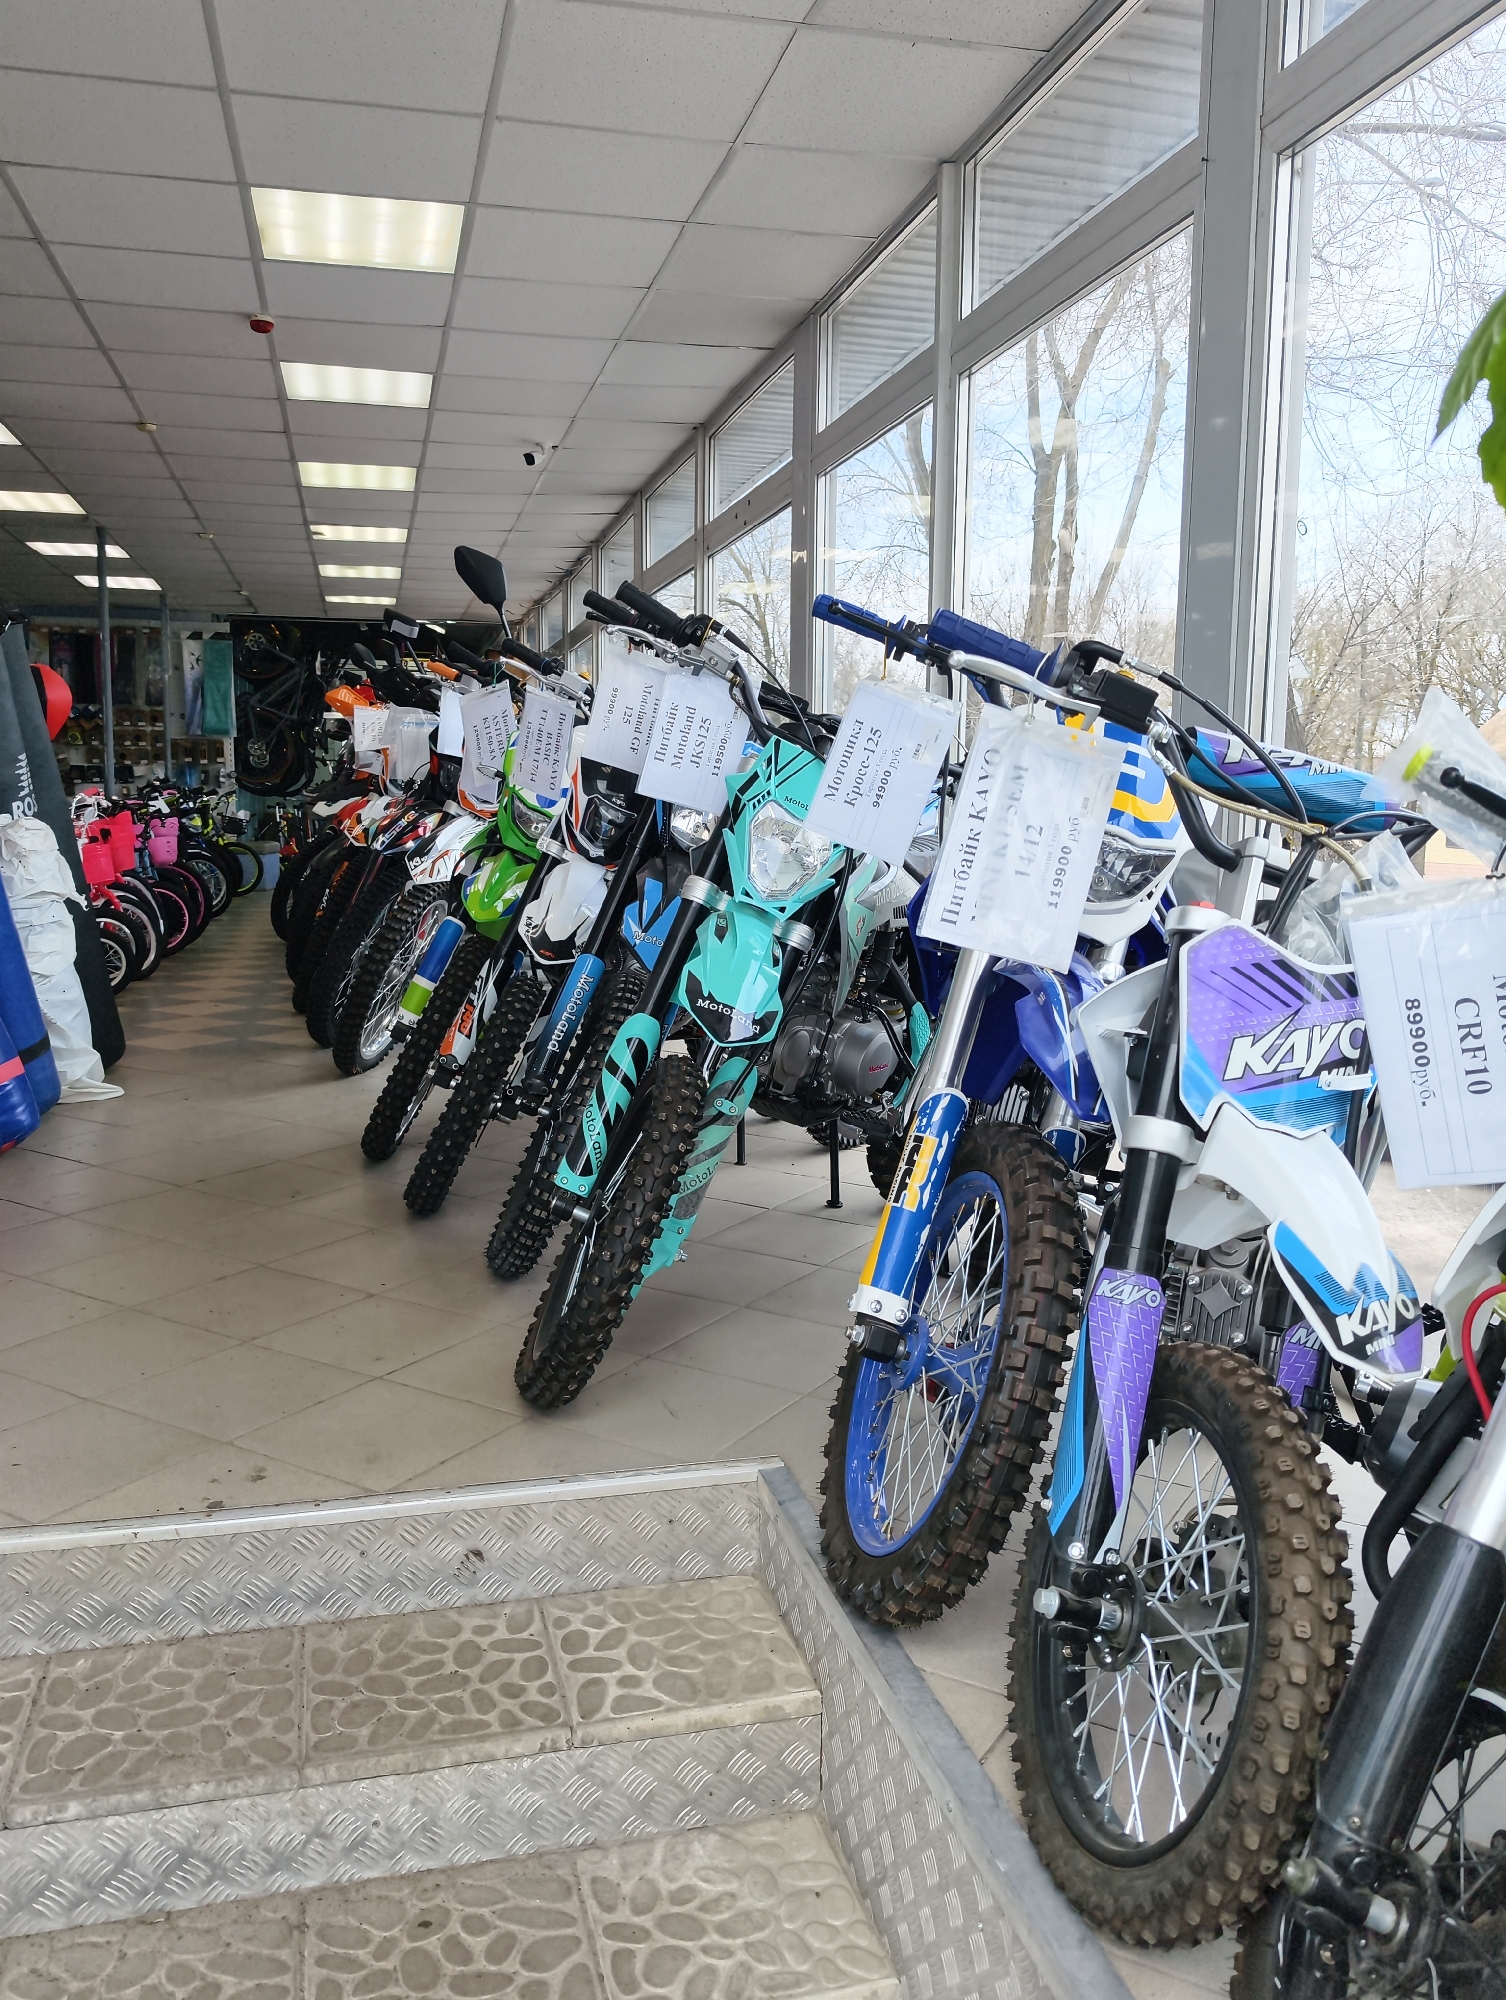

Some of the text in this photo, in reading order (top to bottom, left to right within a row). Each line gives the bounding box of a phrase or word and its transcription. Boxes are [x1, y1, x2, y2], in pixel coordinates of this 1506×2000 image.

[622, 705, 633, 725] 125
[634, 683, 653, 734] Motoland
[653, 702, 679, 763] Питбайк
[671, 706, 696, 769] Motoland
[542, 732, 553, 766] BASIC
[549, 712, 567, 791] Питбайк KAYO
[629, 736, 641, 755] GF
[690, 716, 711, 769] JKS125
[822, 719, 864, 802] Мотоцикл
[843, 726, 883, 808] Кросс-125
[872, 747, 903, 809] 94900 руб.
[939, 748, 1001, 927] Питбайк KAYO
[1014, 823, 1044, 878] 14/12
[1047, 845, 1072, 909] 119900
[547, 972, 595, 1053] MotoLand
[696, 998, 760, 1034] MotoLand
[1454, 998, 1493, 1095] CRF10
[1095, 1277, 1161, 1308] KAYO
[1336, 1284, 1415, 1346] KAYO
[1365, 1333, 1396, 1355] MINI
